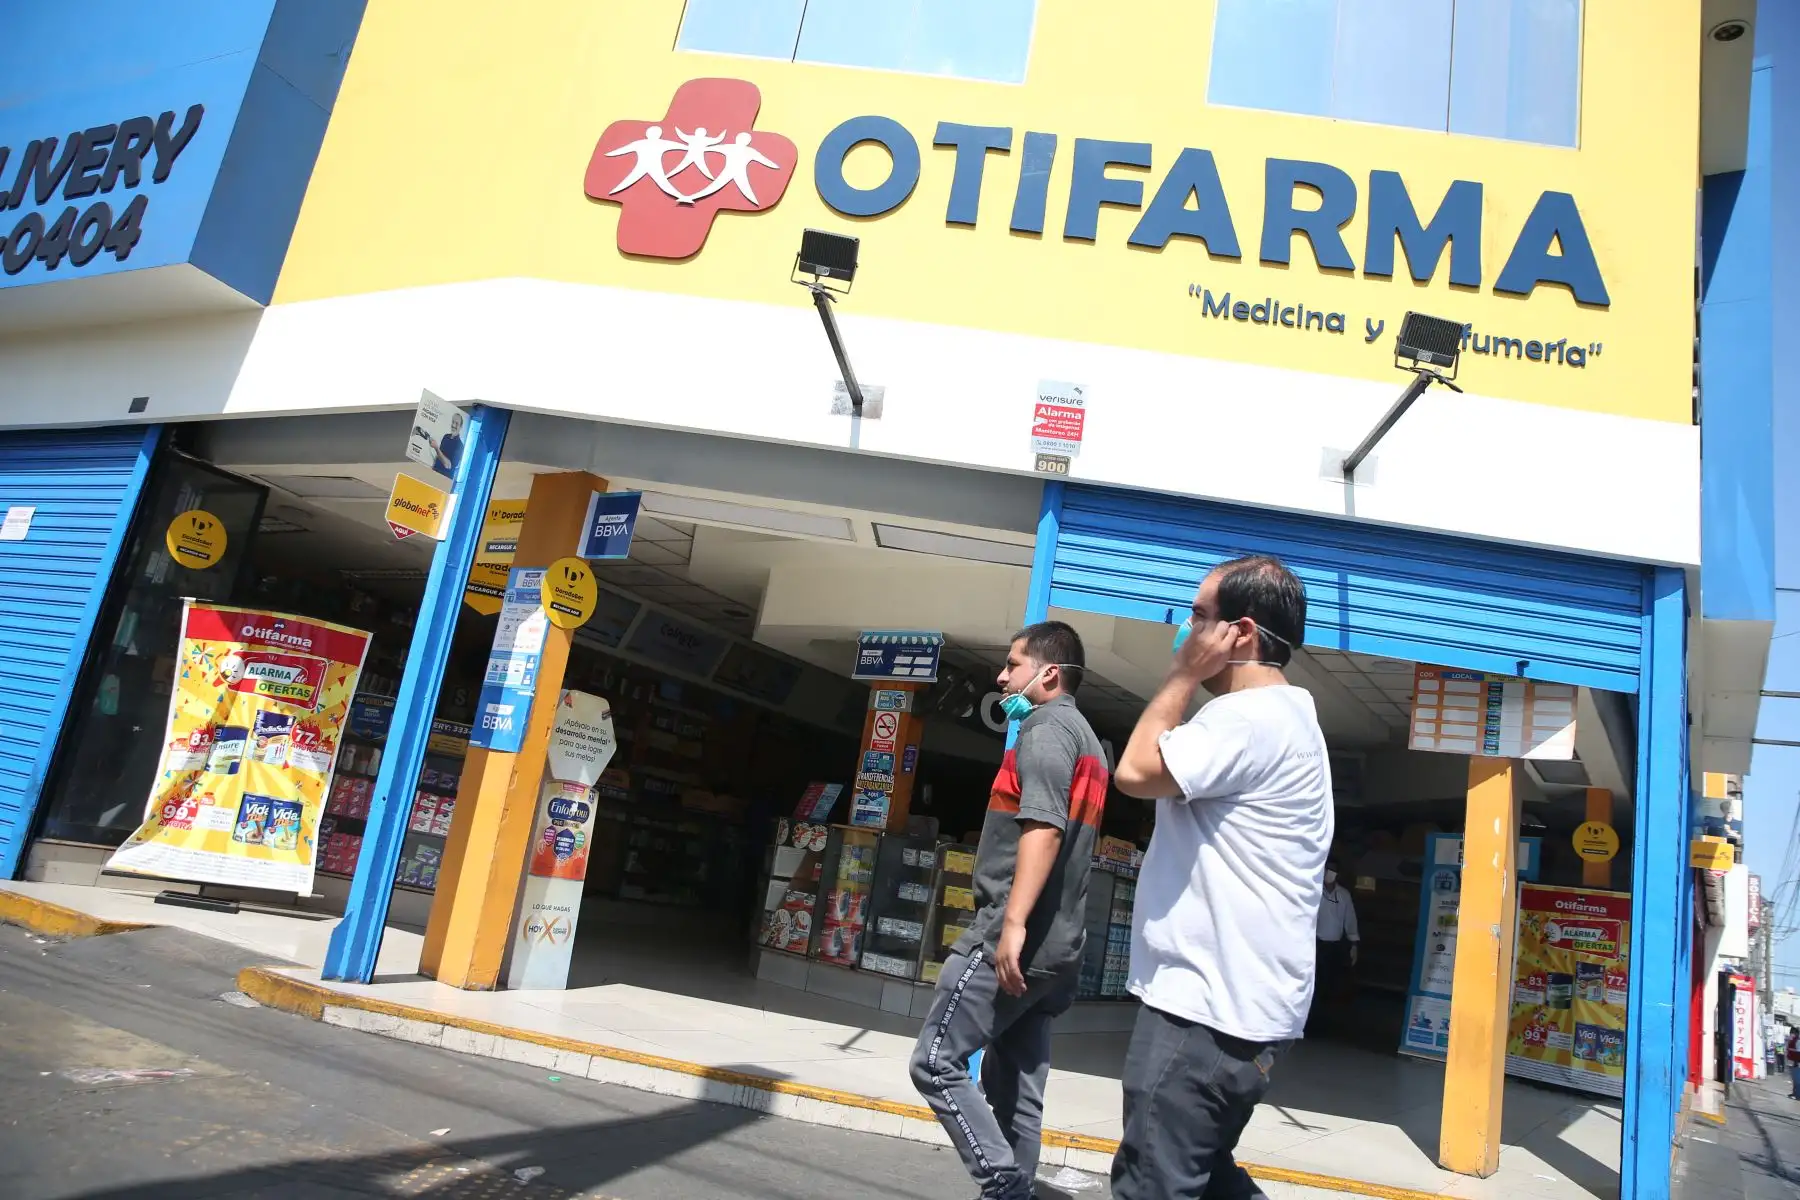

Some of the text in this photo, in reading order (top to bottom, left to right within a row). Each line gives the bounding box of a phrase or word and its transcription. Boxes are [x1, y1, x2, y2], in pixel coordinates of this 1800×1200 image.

[813, 115, 1611, 307] OTIFARMA
[1188, 283, 1346, 333] “Medicina
[1365, 317, 1385, 342] y
[1039, 394, 1083, 406] verisure
[1037, 406, 1082, 420] Alarma
[1038, 460, 1066, 473] 900
[394, 497, 431, 517] globalnet
[595, 523, 628, 537] BBVA
[467, 585, 497, 596] RECARGUE
[242, 624, 312, 647] Otifarma
[861, 656, 884, 665] BBVA
[248, 666, 308, 684] ALARMA de
[258, 682, 311, 698] OFERTAS
[482, 715, 513, 730] BBVA
[555, 727, 586, 740] desarrollo
[559, 738, 574, 748] para
[574, 742, 587, 751] que
[564, 750, 575, 758] sus
[273, 808, 299, 821] Vida
[158, 819, 193, 831] AHORA
[1749, 877, 1760, 923] BOTICA
[1555, 900, 1607, 914] Otifarma
[528, 925, 544, 934] HOY
[1563, 929, 1597, 939] ALARMA
[1574, 940, 1614, 951] OFERTAS
[961, 969, 974, 982] GIVE
[957, 981, 966, 990] UP
[1736, 997, 1746, 1055] LOAYZA
[949, 1102, 958, 1111] UP
[956, 1113, 982, 1156] NEVER GIVE UP
